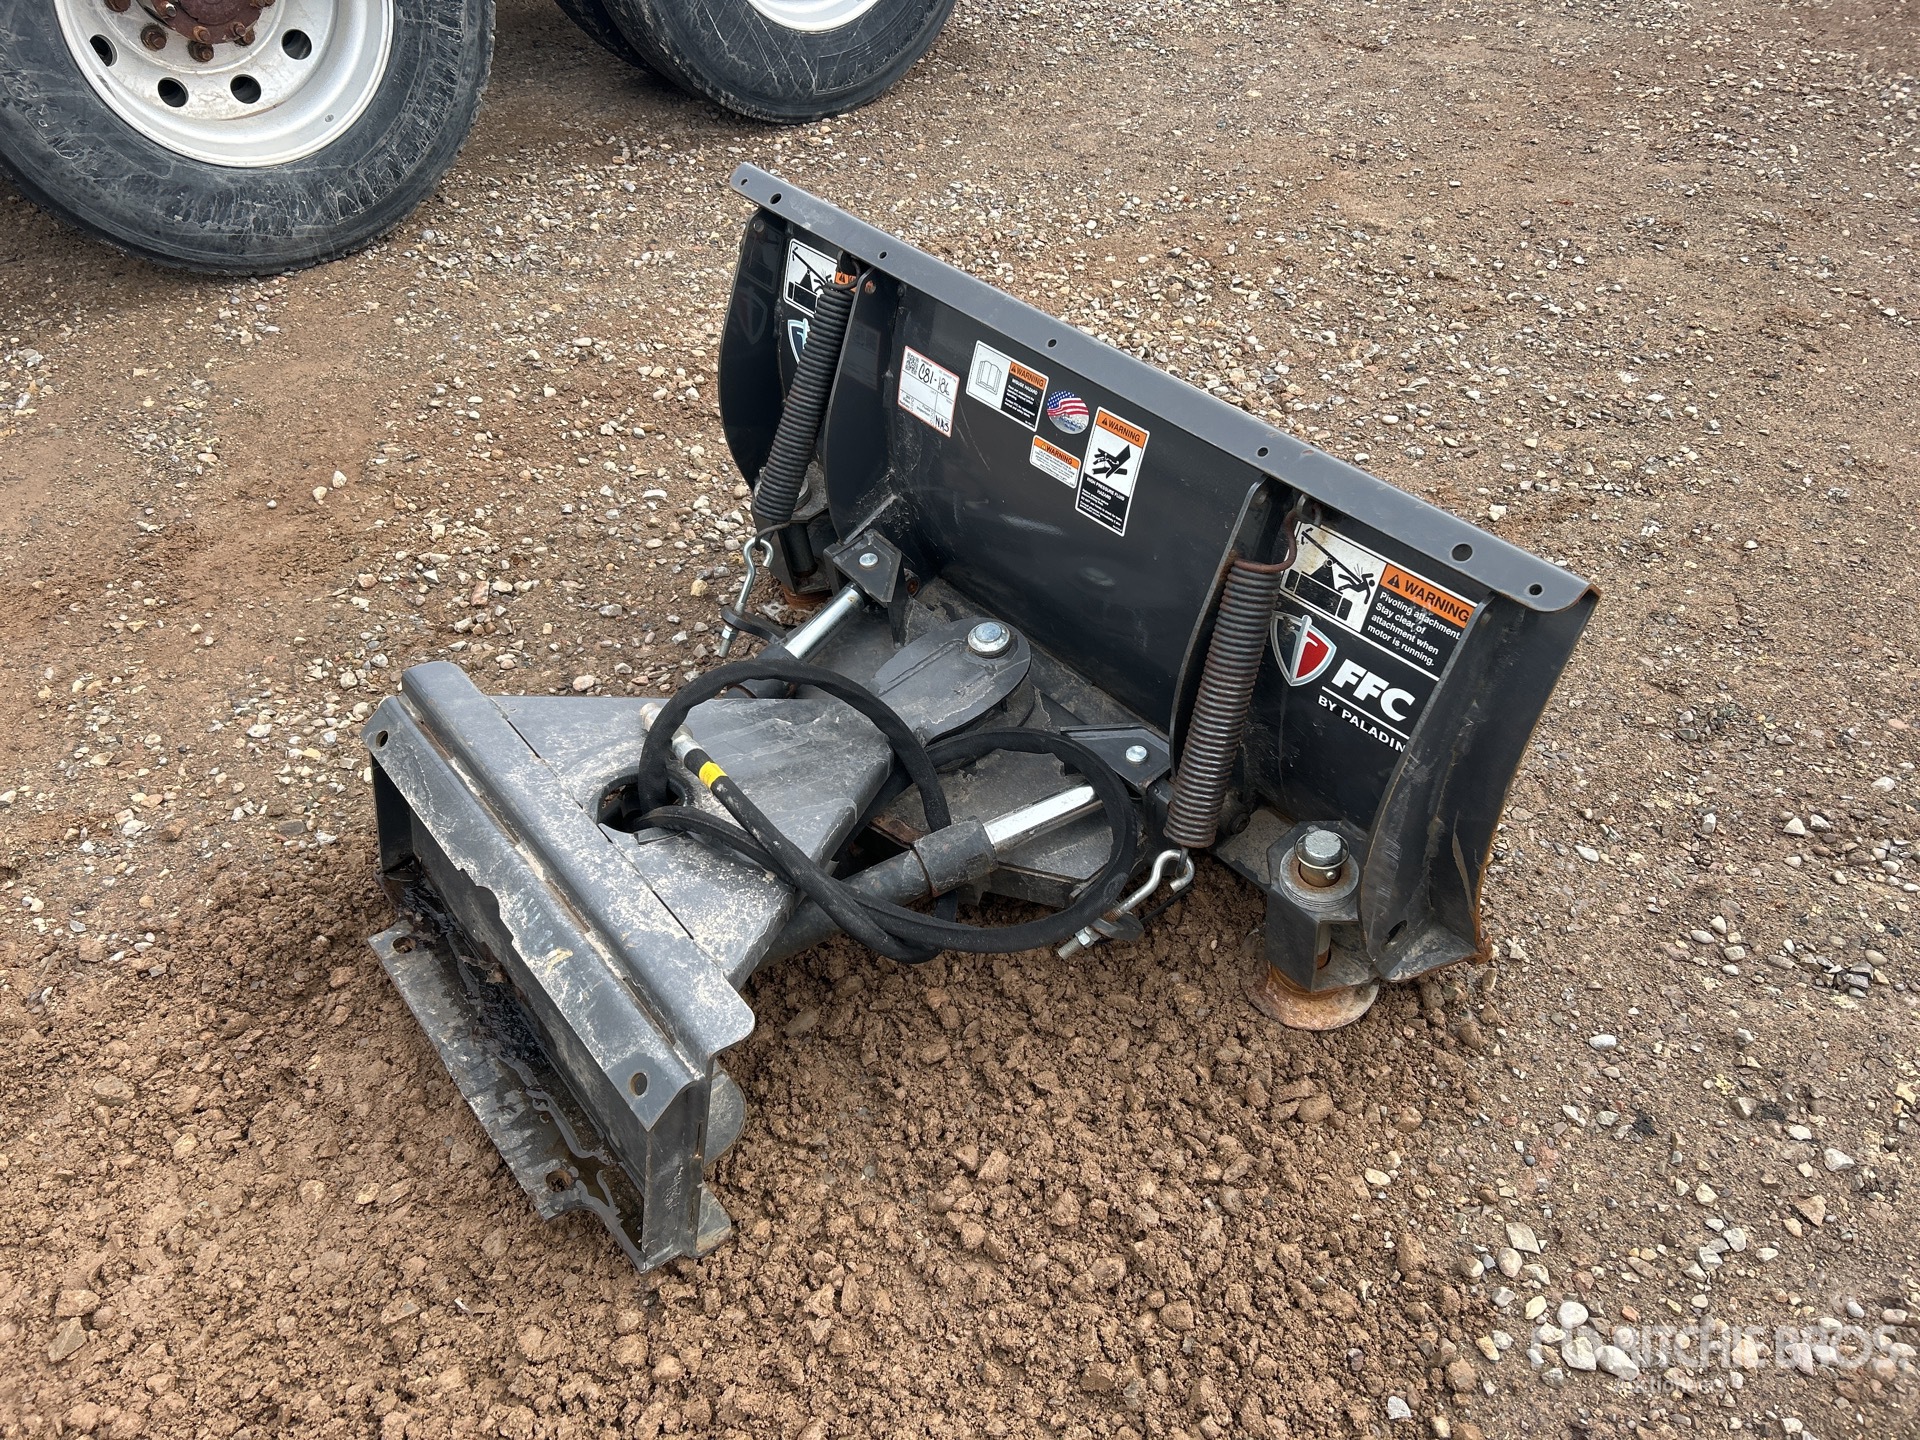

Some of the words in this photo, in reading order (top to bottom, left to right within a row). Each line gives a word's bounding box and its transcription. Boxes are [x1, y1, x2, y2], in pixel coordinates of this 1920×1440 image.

[1015, 366, 1045, 388] WARNING
[1108, 420, 1141, 443] WARNING
[1045, 444, 1073, 465] WARNING
[1375, 602, 1394, 622] Stay
[1394, 613, 1417, 629] clear
[1416, 624, 1427, 635] of
[1379, 591, 1414, 616] Pivoting
[1404, 579, 1470, 623] WARNING
[1367, 624, 1392, 642] motor
[1392, 635, 1401, 647] is
[1400, 642, 1435, 667] running.
[1371, 614, 1415, 643] attachment
[1416, 638, 1439, 655] when
[1331, 658, 1416, 722] FFC
[1318, 694, 1337, 712] BY
[1341, 708, 1406, 753] PALADIN
